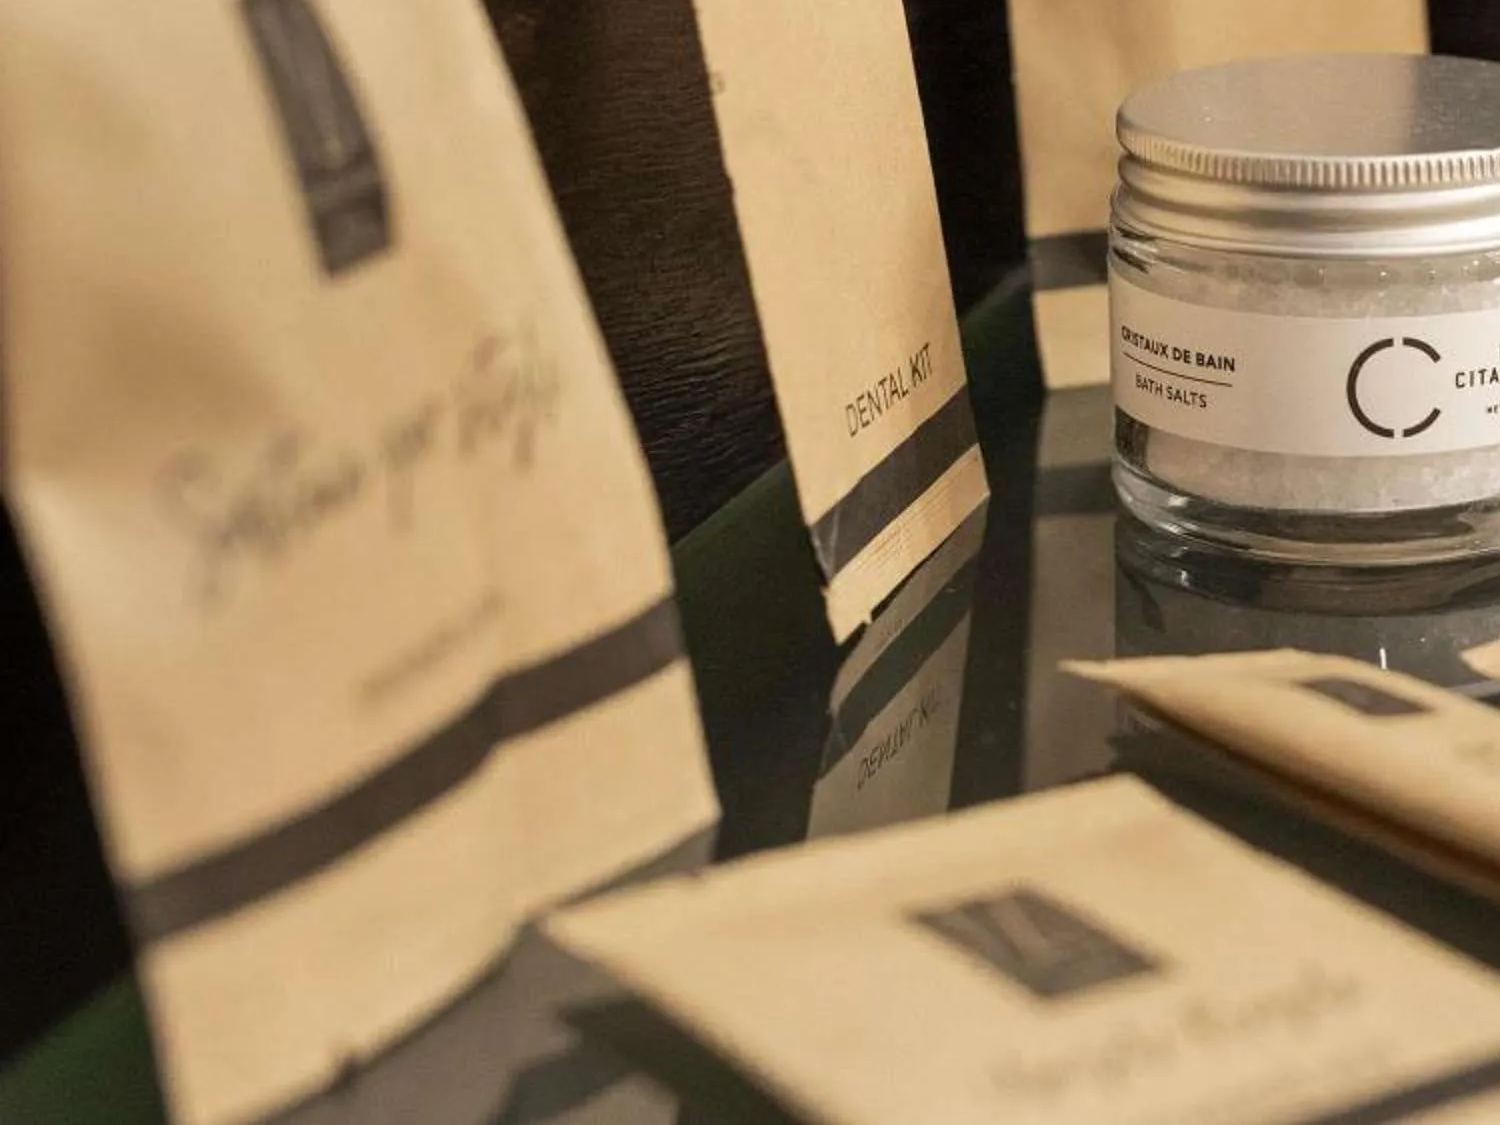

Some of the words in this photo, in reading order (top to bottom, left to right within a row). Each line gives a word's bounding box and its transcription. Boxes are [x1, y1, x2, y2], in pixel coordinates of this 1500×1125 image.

[1121, 325, 1169, 360] CRISTAUX
[1171, 346, 1192, 365] DE
[1195, 351, 1236, 373] BAIN
[845, 366, 909, 437] DENTAL
[909, 342, 934, 387] KIT
[1135, 373, 1164, 396] BATH
[1165, 386, 1208, 409] SALTS
